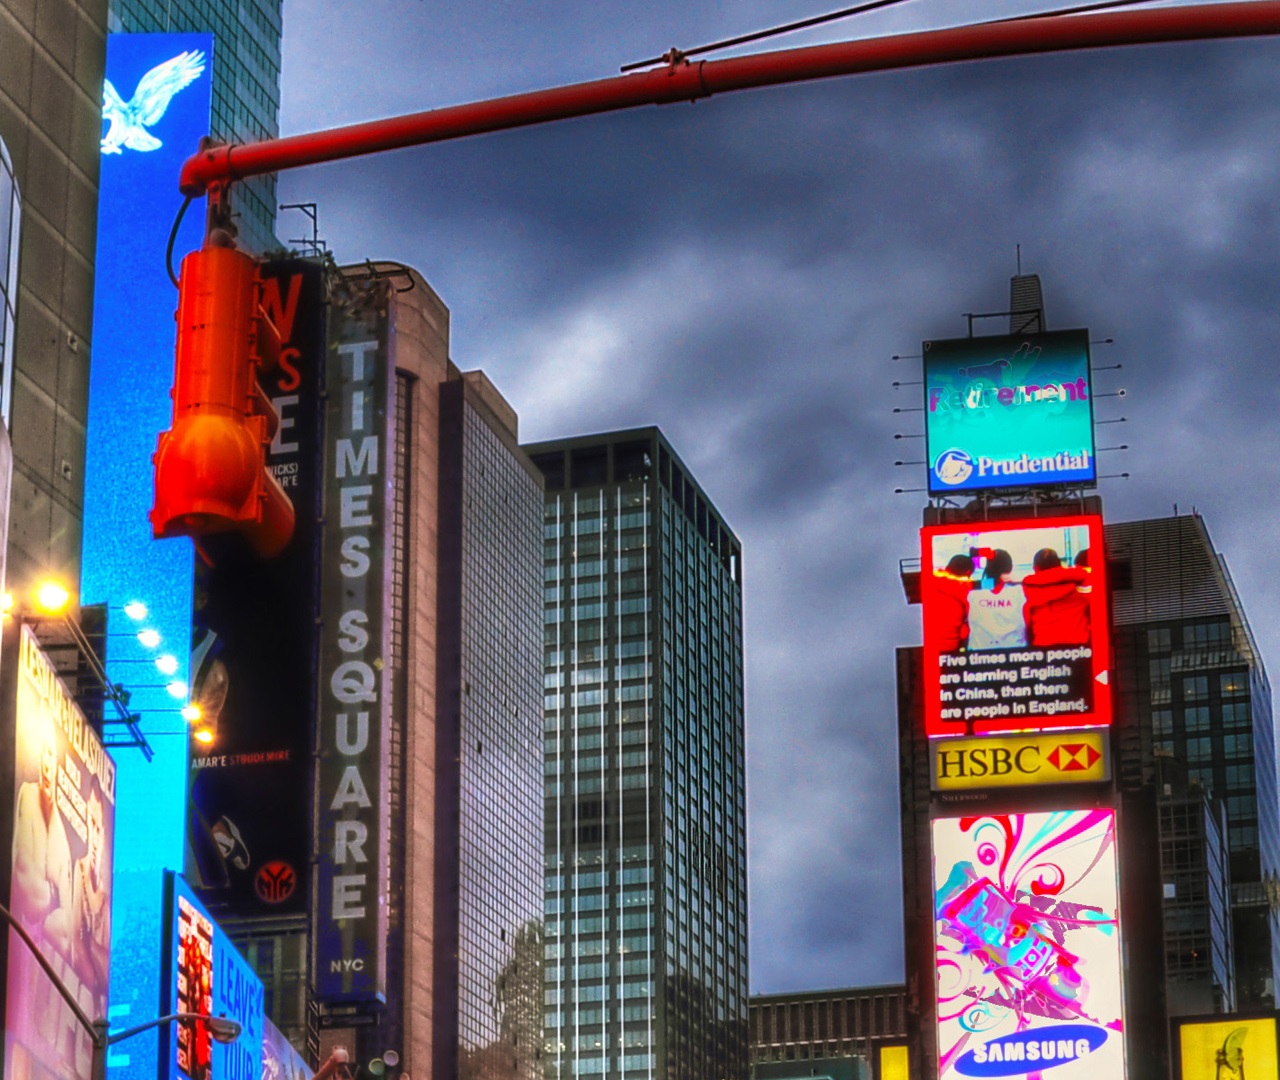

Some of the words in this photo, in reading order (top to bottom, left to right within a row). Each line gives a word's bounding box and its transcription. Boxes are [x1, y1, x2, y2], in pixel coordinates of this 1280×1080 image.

[334, 340, 380, 580] TIMES
[977, 449, 1089, 477] Prudential
[979, 599, 1012, 608] CHINA
[939, 654, 966, 667] Five
[969, 652, 1006, 666] times
[1009, 650, 1043, 663] more
[1047, 647, 1092, 661] people
[939, 674, 961, 685] are
[963, 669, 1018, 683] learning
[1020, 664, 1072, 680] English
[940, 690, 953, 701] in
[956, 687, 998, 701] China,
[1001, 684, 1032, 697] than
[1034, 682, 1069, 695] there
[940, 707, 962, 719] are
[964, 703, 1010, 720] people
[1013, 701, 1026, 714] in
[1029, 698, 1088, 715] England.
[192, 755, 227, 770] AMAR'E
[230, 750, 290, 766] STOUDEMIRE
[330, 608, 378, 921] SQUARE
[938, 745, 1041, 779] HSBC
[330, 957, 365, 975] NYC
[220, 948, 255, 1037] LEAVE
[973, 1038, 1092, 1065] SAMSUNG
